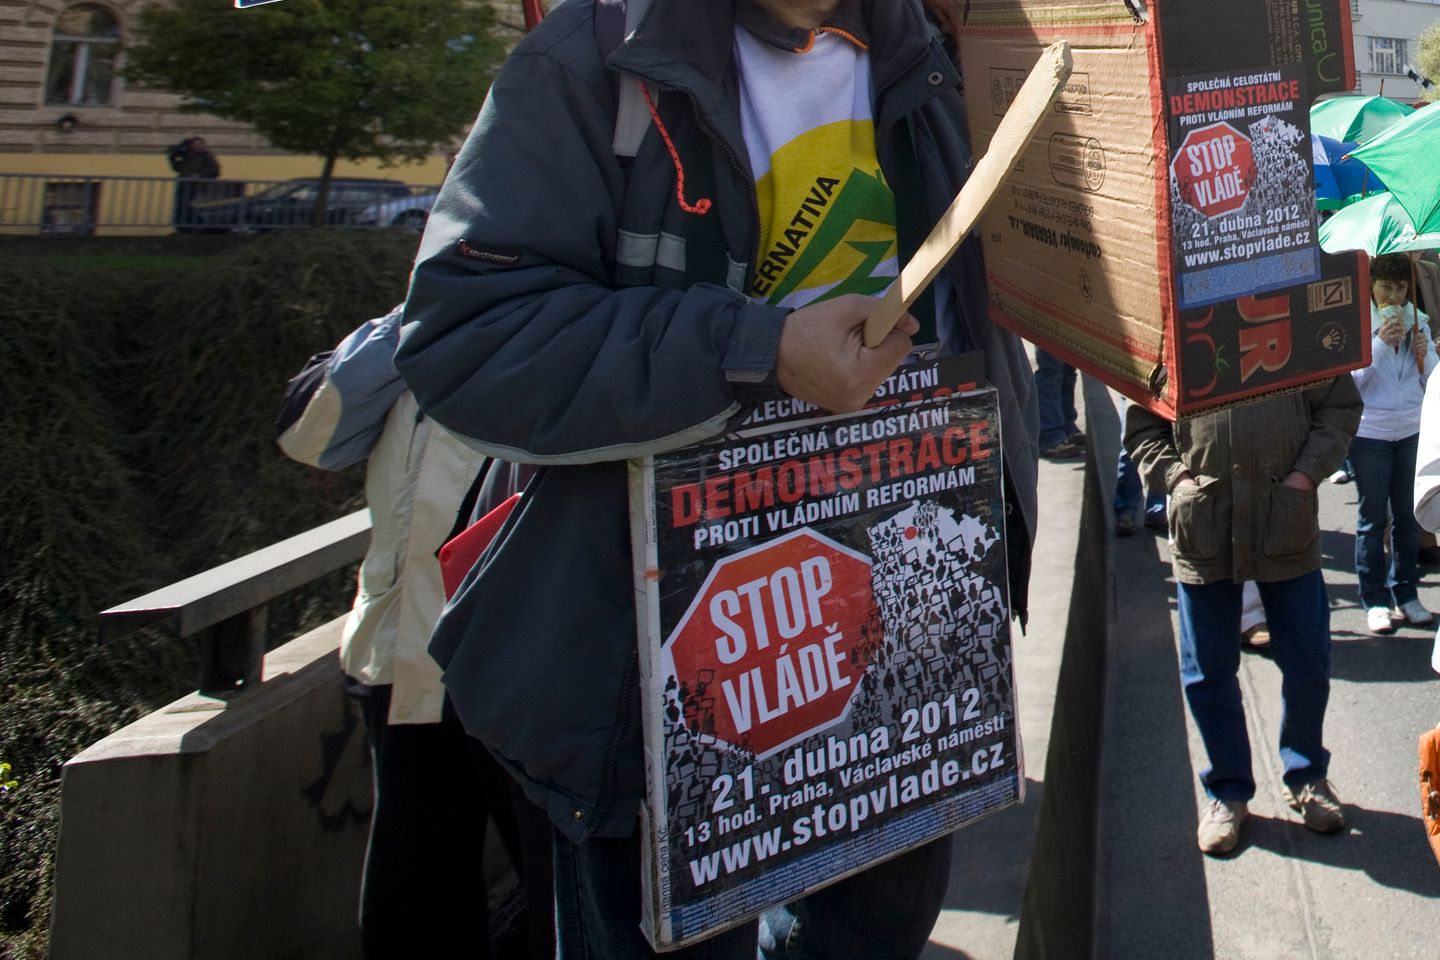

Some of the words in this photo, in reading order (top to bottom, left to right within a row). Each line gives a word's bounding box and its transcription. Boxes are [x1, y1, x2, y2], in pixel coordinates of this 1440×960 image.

[1170, 80, 1299, 115] DEMONSTRACE
[1187, 76, 1231, 93] SPOLEČNÁ
[1233, 69, 1281, 87] CELOSTÁTNÍ
[1180, 112, 1206, 126] PROTI
[1207, 106, 1245, 123] VLÁDNÍM
[1247, 100, 1293, 117] REFORMÁM
[1186, 134, 1236, 177] STOP
[1194, 165, 1245, 208] VLÁDĚ
[1182, 241, 1192, 251] 13
[1195, 238, 1212, 249] hod.
[1215, 233, 1239, 245] Praha,
[1242, 224, 1279, 239] Václavské
[1191, 220, 1214, 238] 21.
[1219, 214, 1261, 233] dubna
[1266, 204, 1299, 224] 2012
[1185, 231, 1310, 268] www.stopvlade.cz
[718, 426, 828, 471] SPOLEČNÁ
[835, 402, 950, 446] CELOSTÁTNÍ
[671, 420, 993, 529] DEMONSTRACE
[694, 513, 759, 550] PROTI
[769, 490, 860, 536] VLÁDNÍM
[867, 461, 975, 507] REFORMÁM
[709, 555, 833, 665] STOP
[721, 622, 851, 734] VLÁDĚ
[711, 765, 771, 813] 21.
[784, 725, 890, 786] dubna
[900, 687, 982, 743] 2012
[683, 822, 712, 847] 13
[718, 803, 762, 836] hod.
[769, 781, 834, 817] Praha,
[839, 742, 931, 788] Václavské
[937, 711, 1006, 753] náměstí
[689, 742, 1005, 887] www.stopvlade.cz
